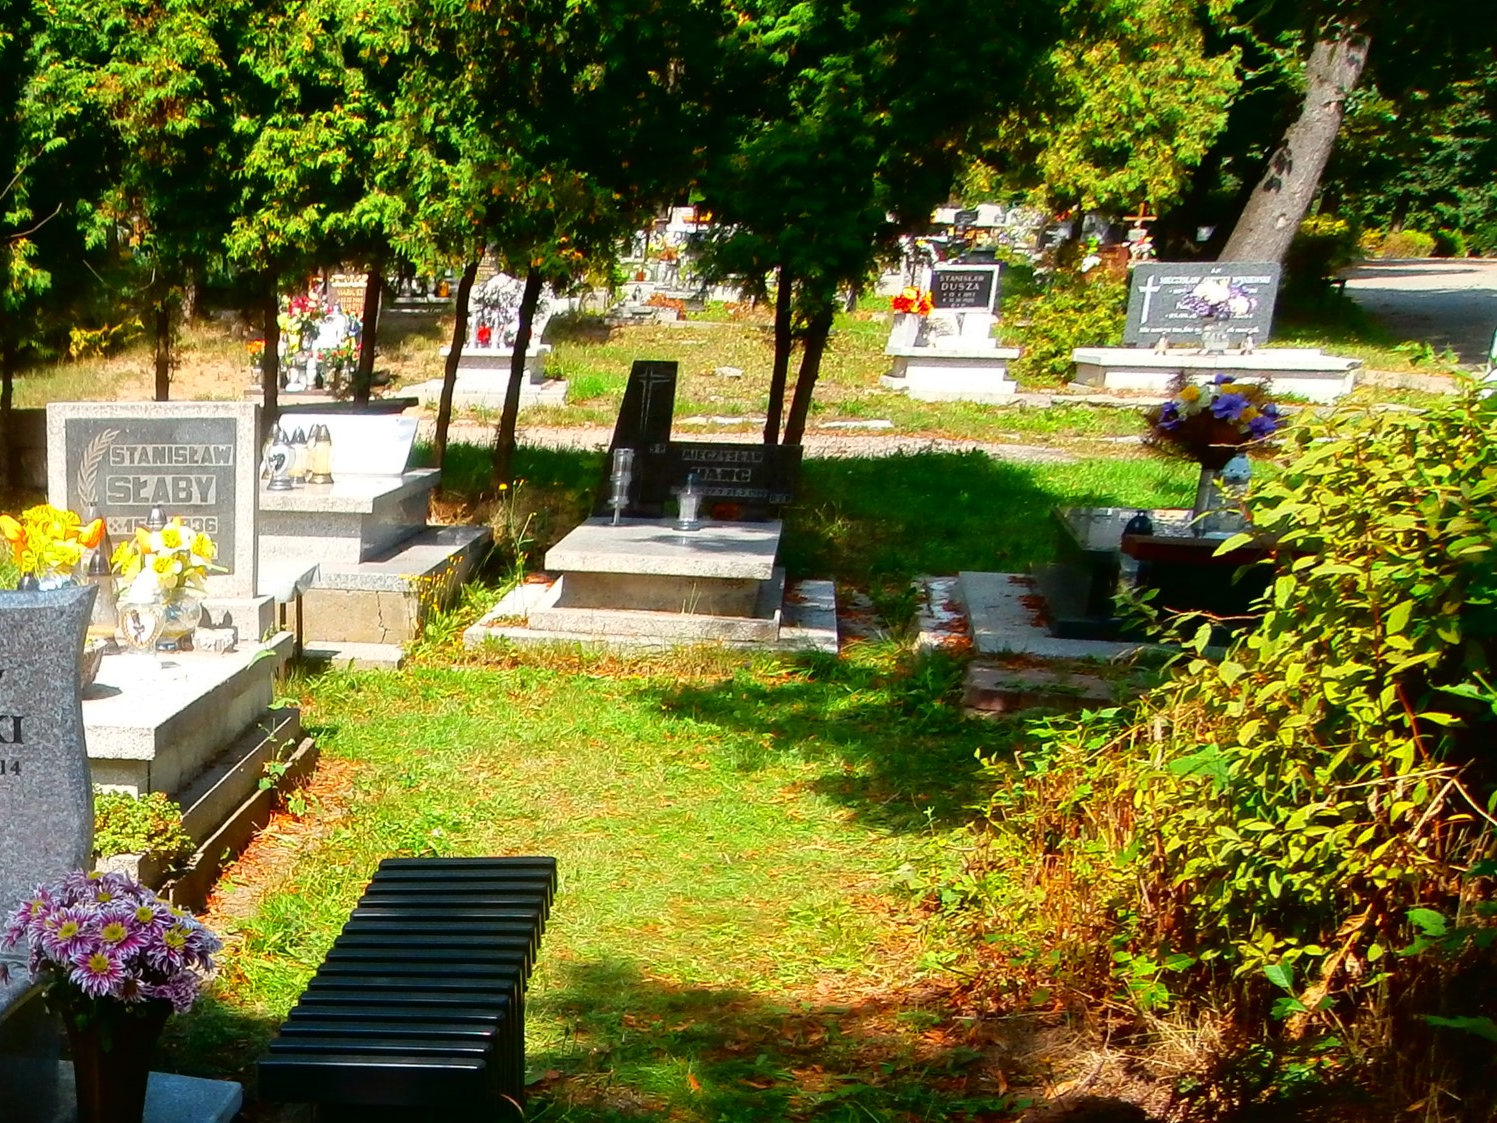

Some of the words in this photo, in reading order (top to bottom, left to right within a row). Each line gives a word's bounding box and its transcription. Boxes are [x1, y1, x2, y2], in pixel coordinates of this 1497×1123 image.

[940, 282, 980, 291] DUSZA
[110, 444, 233, 466] STANISŁAW
[106, 475, 216, 505] SŁABY
